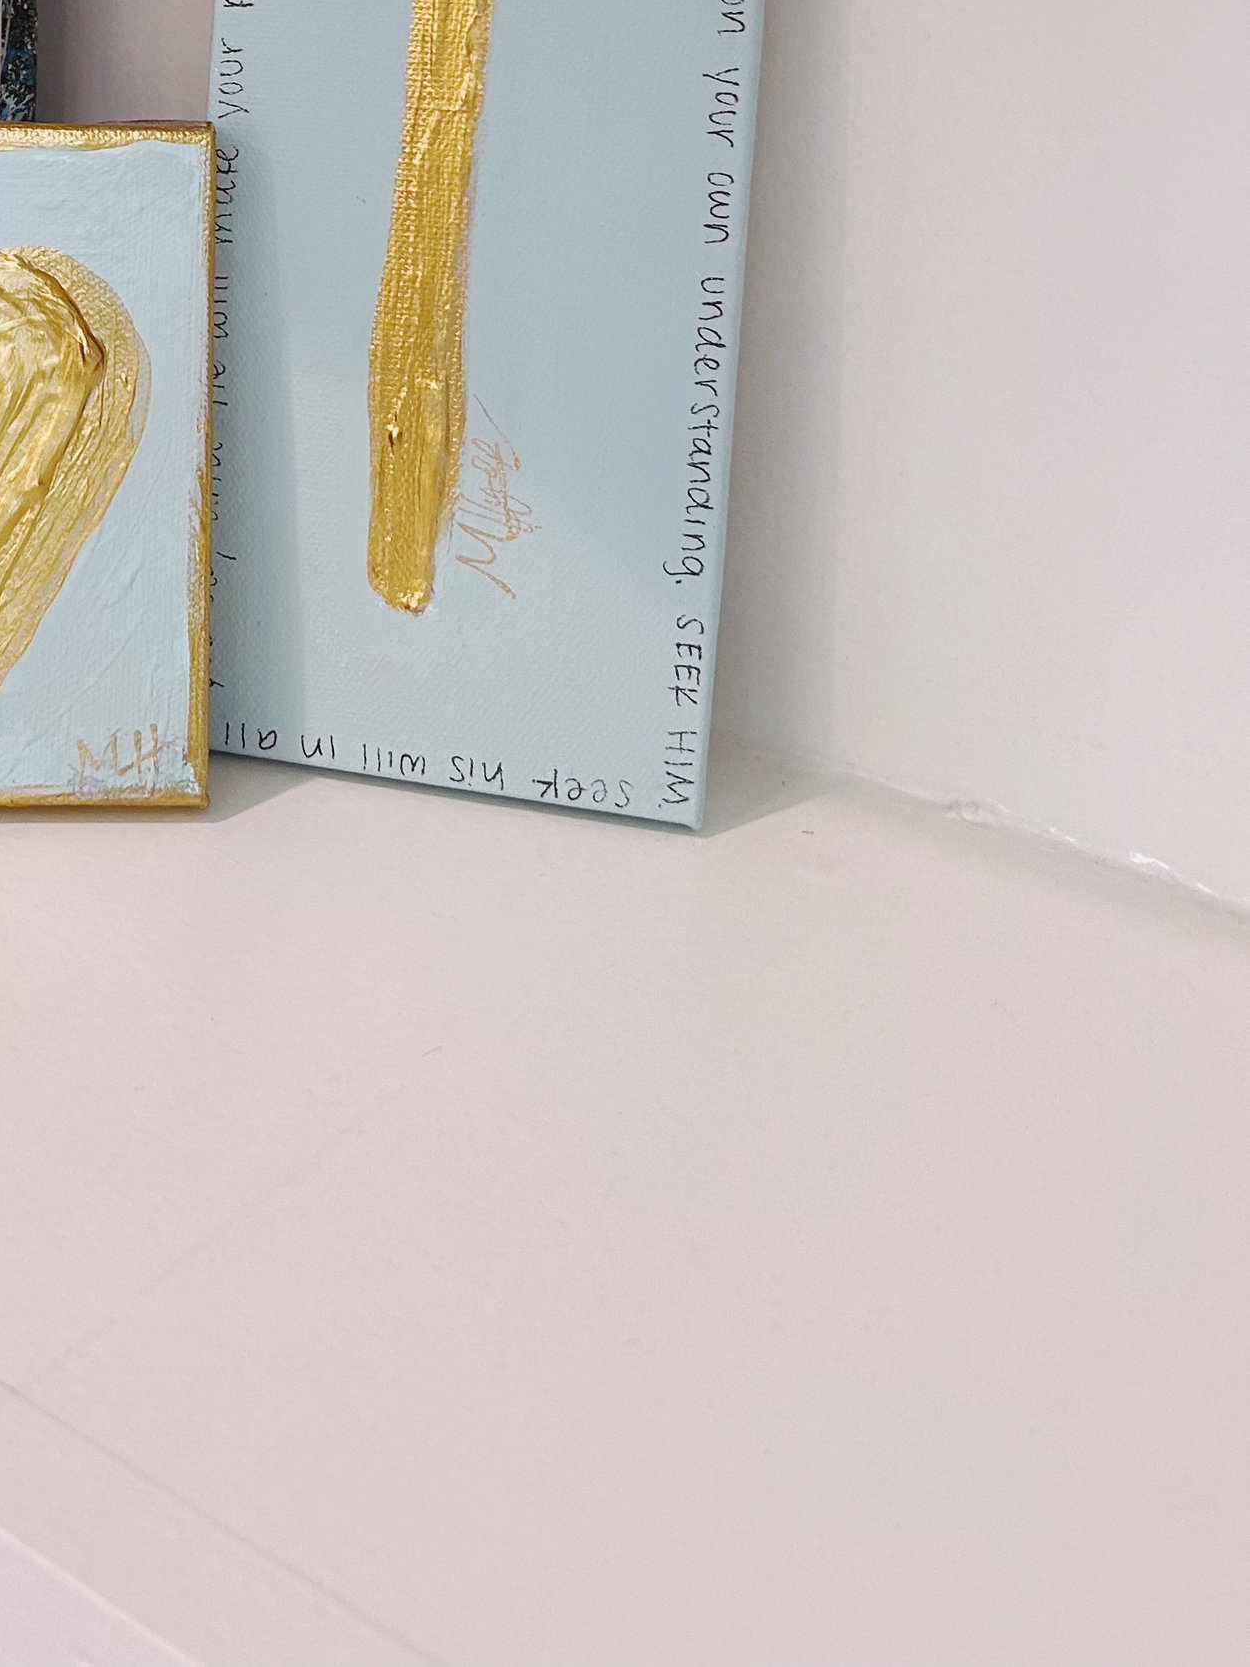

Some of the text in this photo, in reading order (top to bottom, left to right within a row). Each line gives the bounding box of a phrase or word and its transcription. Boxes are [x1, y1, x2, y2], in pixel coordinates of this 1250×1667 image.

[217, 37, 251, 119] your
[702, 67, 741, 149] your
[704, 171, 730, 244] own
[662, 276, 727, 585] understanding.
[667, 613, 705, 708] SEEK
[224, 721, 636, 809] seek his will in all
